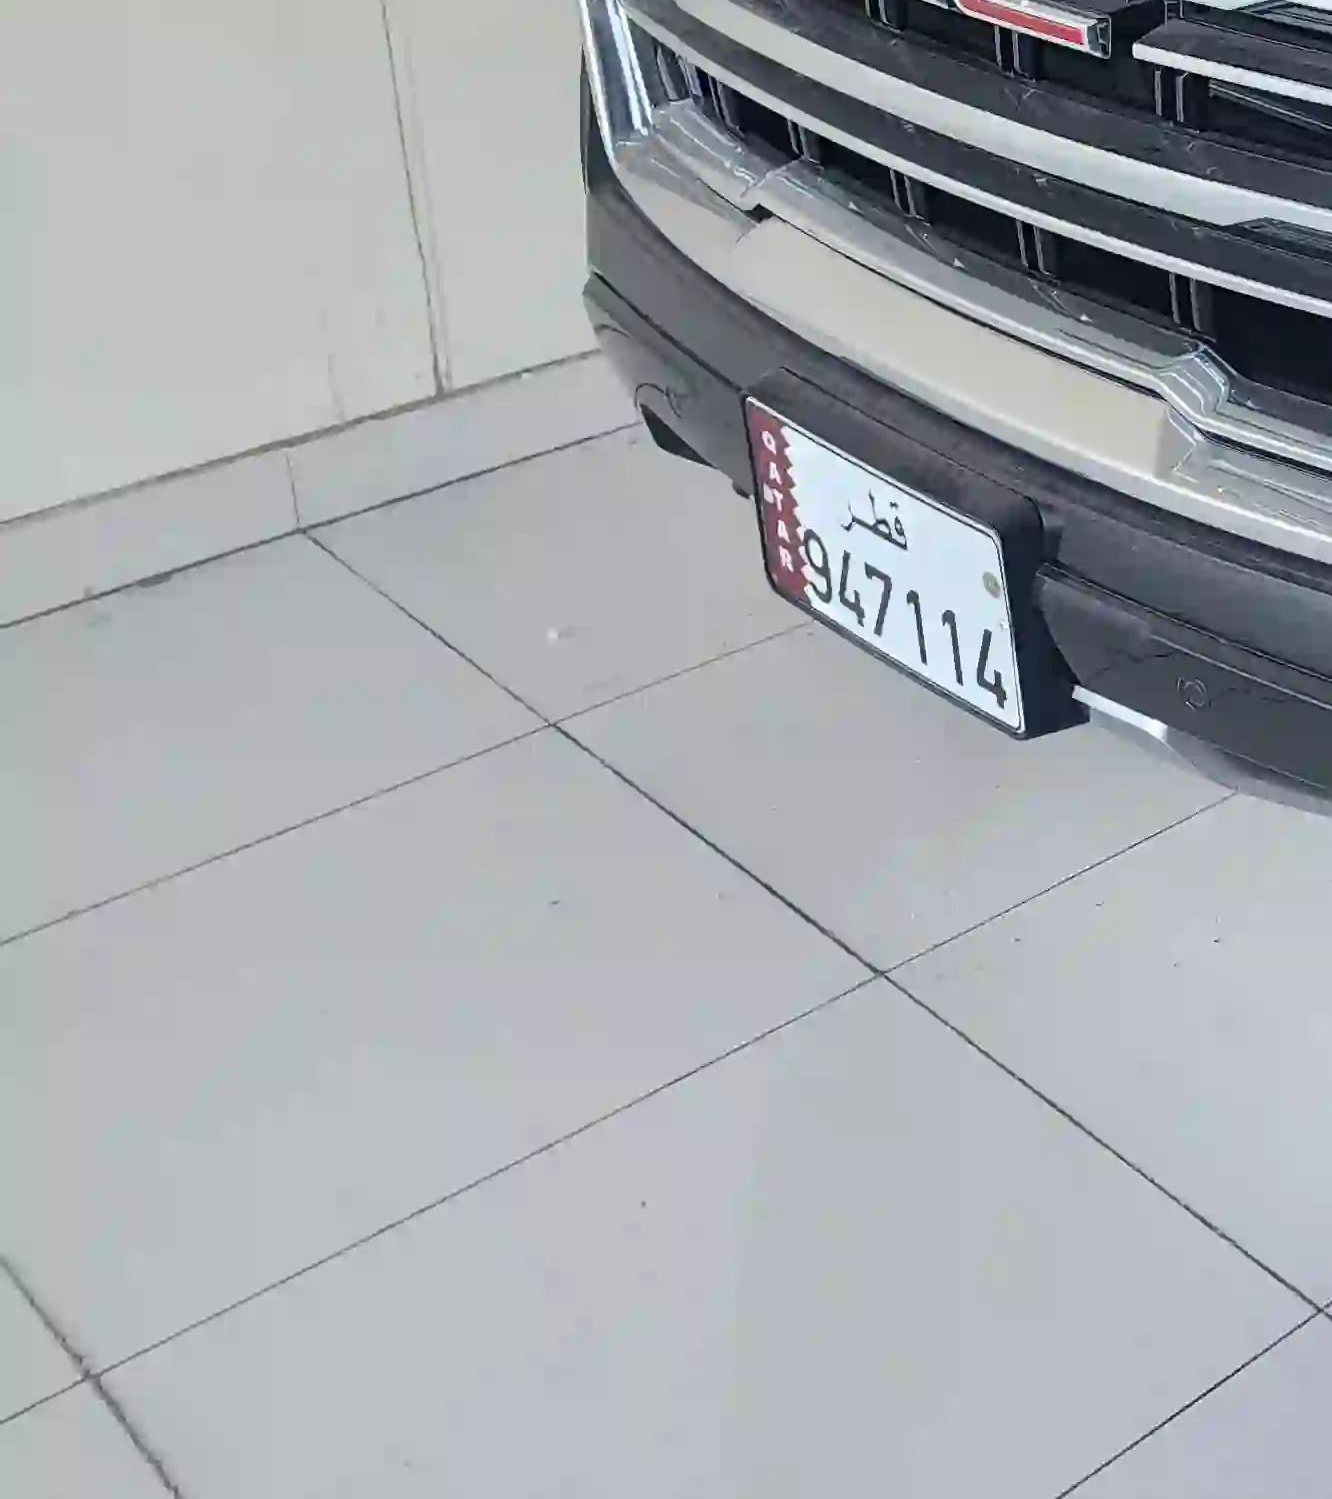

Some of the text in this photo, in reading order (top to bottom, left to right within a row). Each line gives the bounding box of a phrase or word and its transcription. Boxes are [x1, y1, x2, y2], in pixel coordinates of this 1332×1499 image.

[761, 430, 795, 573] QATAR
[841, 488, 908, 552] قطر
[802, 527, 1008, 710] 947114
